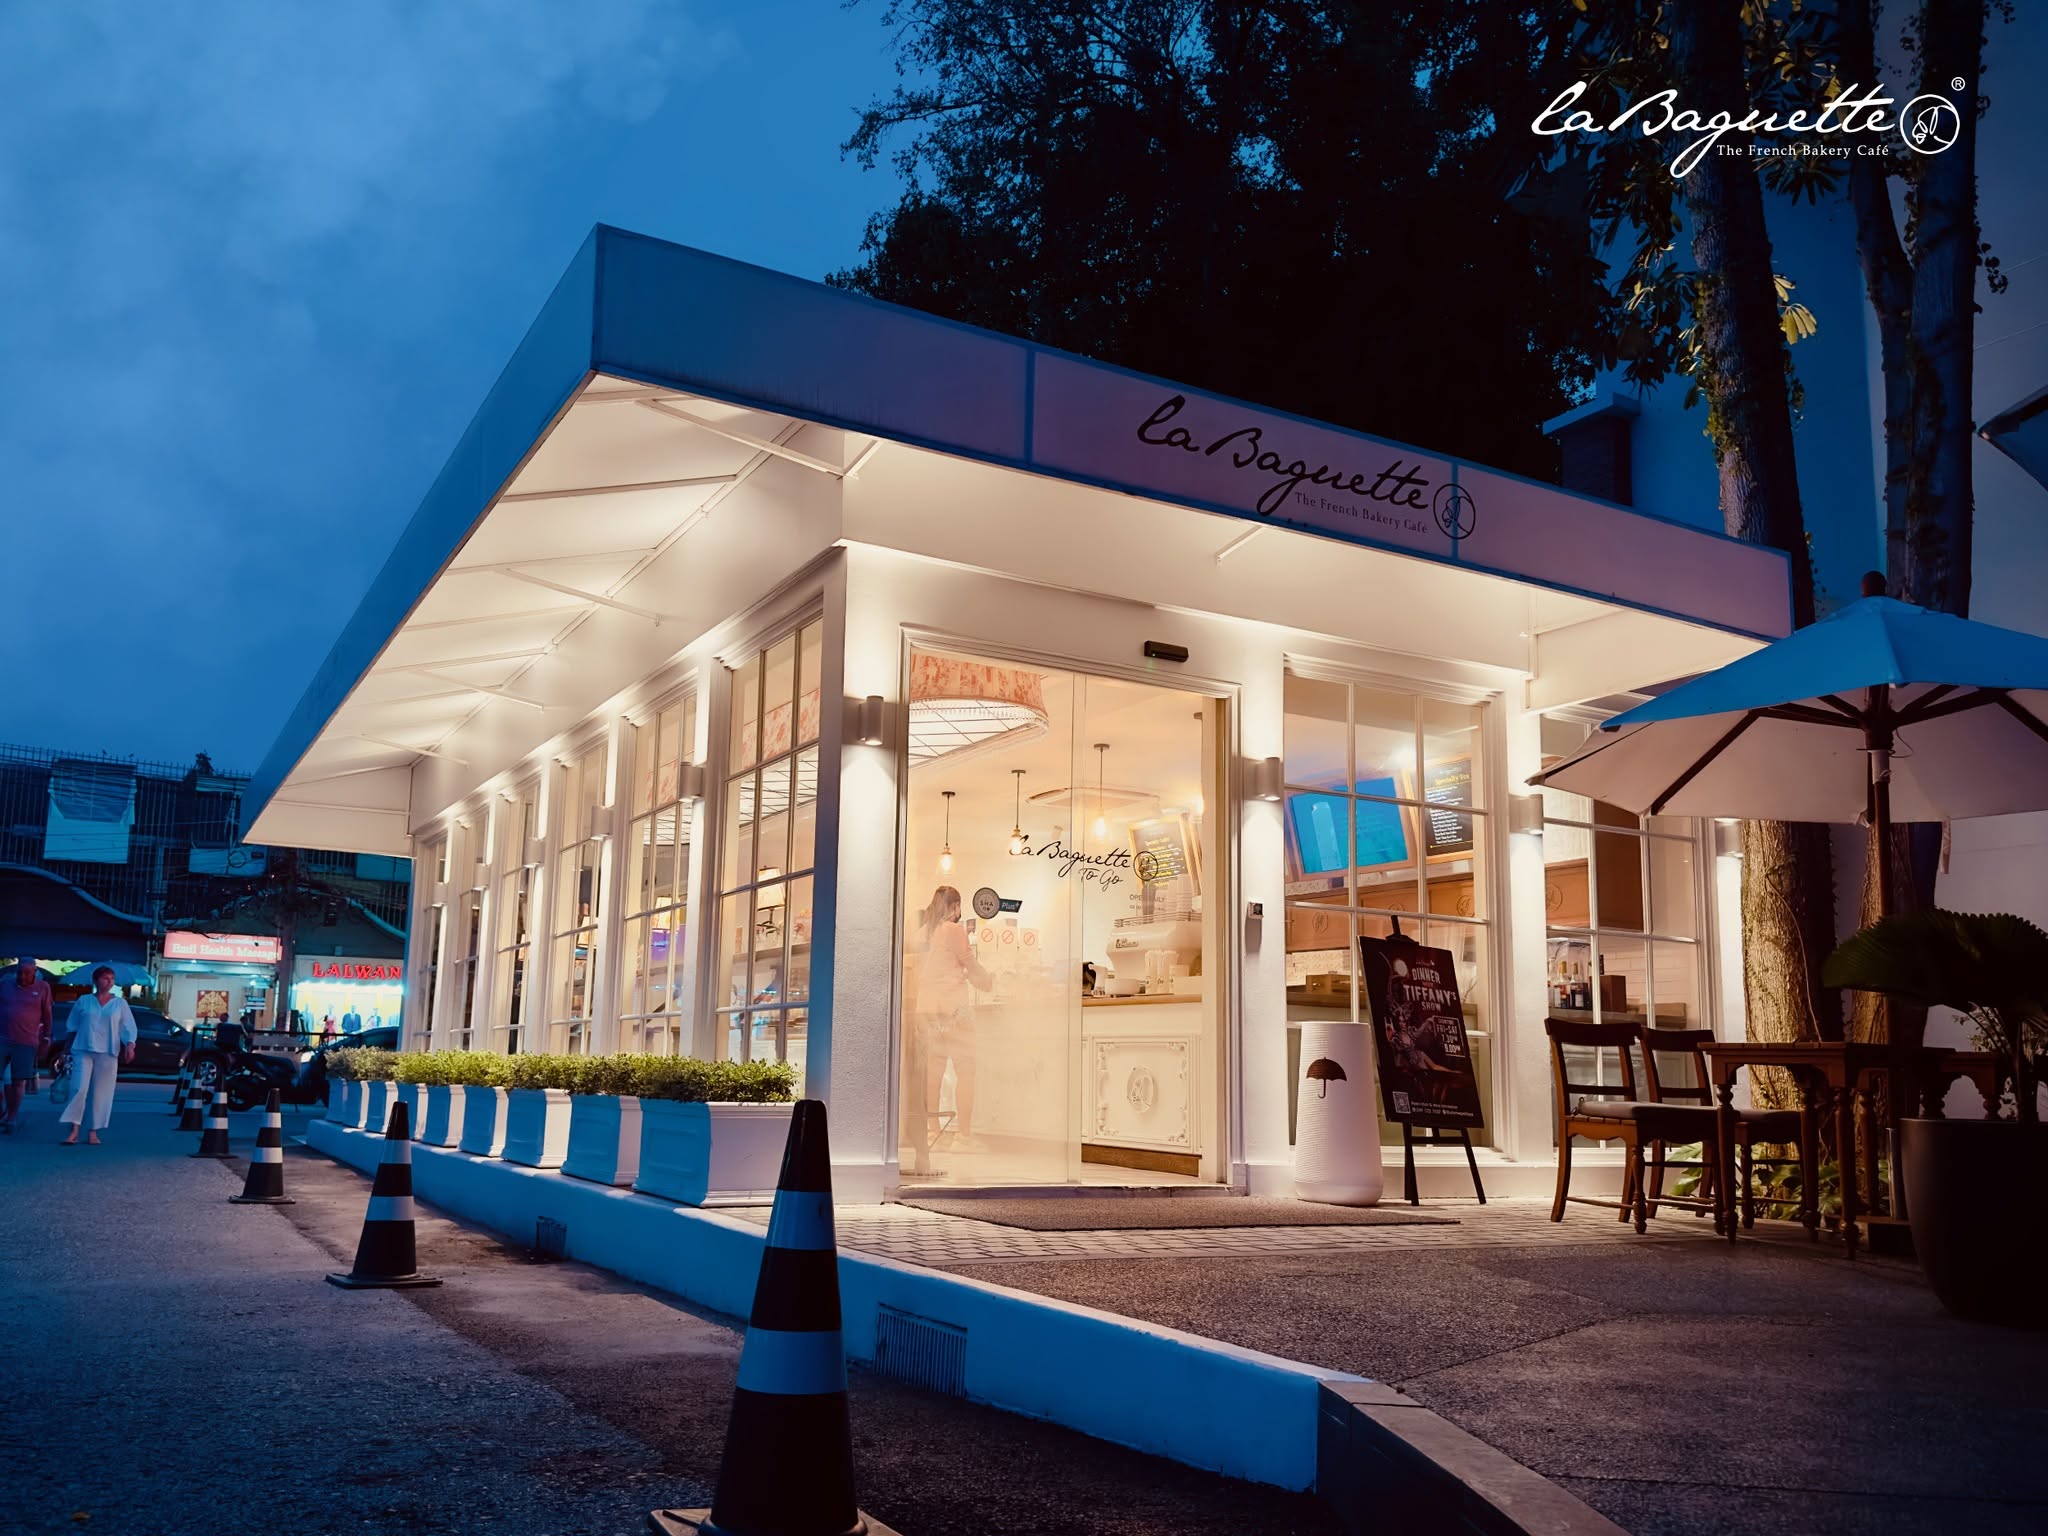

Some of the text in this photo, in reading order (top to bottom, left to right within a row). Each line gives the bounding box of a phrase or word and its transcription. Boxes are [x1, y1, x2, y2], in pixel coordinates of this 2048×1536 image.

[1205, 426, 1430, 517] Baguette
[1295, 491, 1316, 508] The
[1320, 497, 1358, 518] French
[1362, 507, 1401, 530] Bakery
[1037, 840, 1131, 878] Baguette
[1078, 867, 1124, 892] To Go
[199, 945, 233, 956] Health
[236, 946, 279, 960] Massage
[1411, 967, 1441, 984] DINNER
[1403, 984, 1457, 1006] TIFFANY'S
[1421, 1002, 1441, 1013] SHOW
